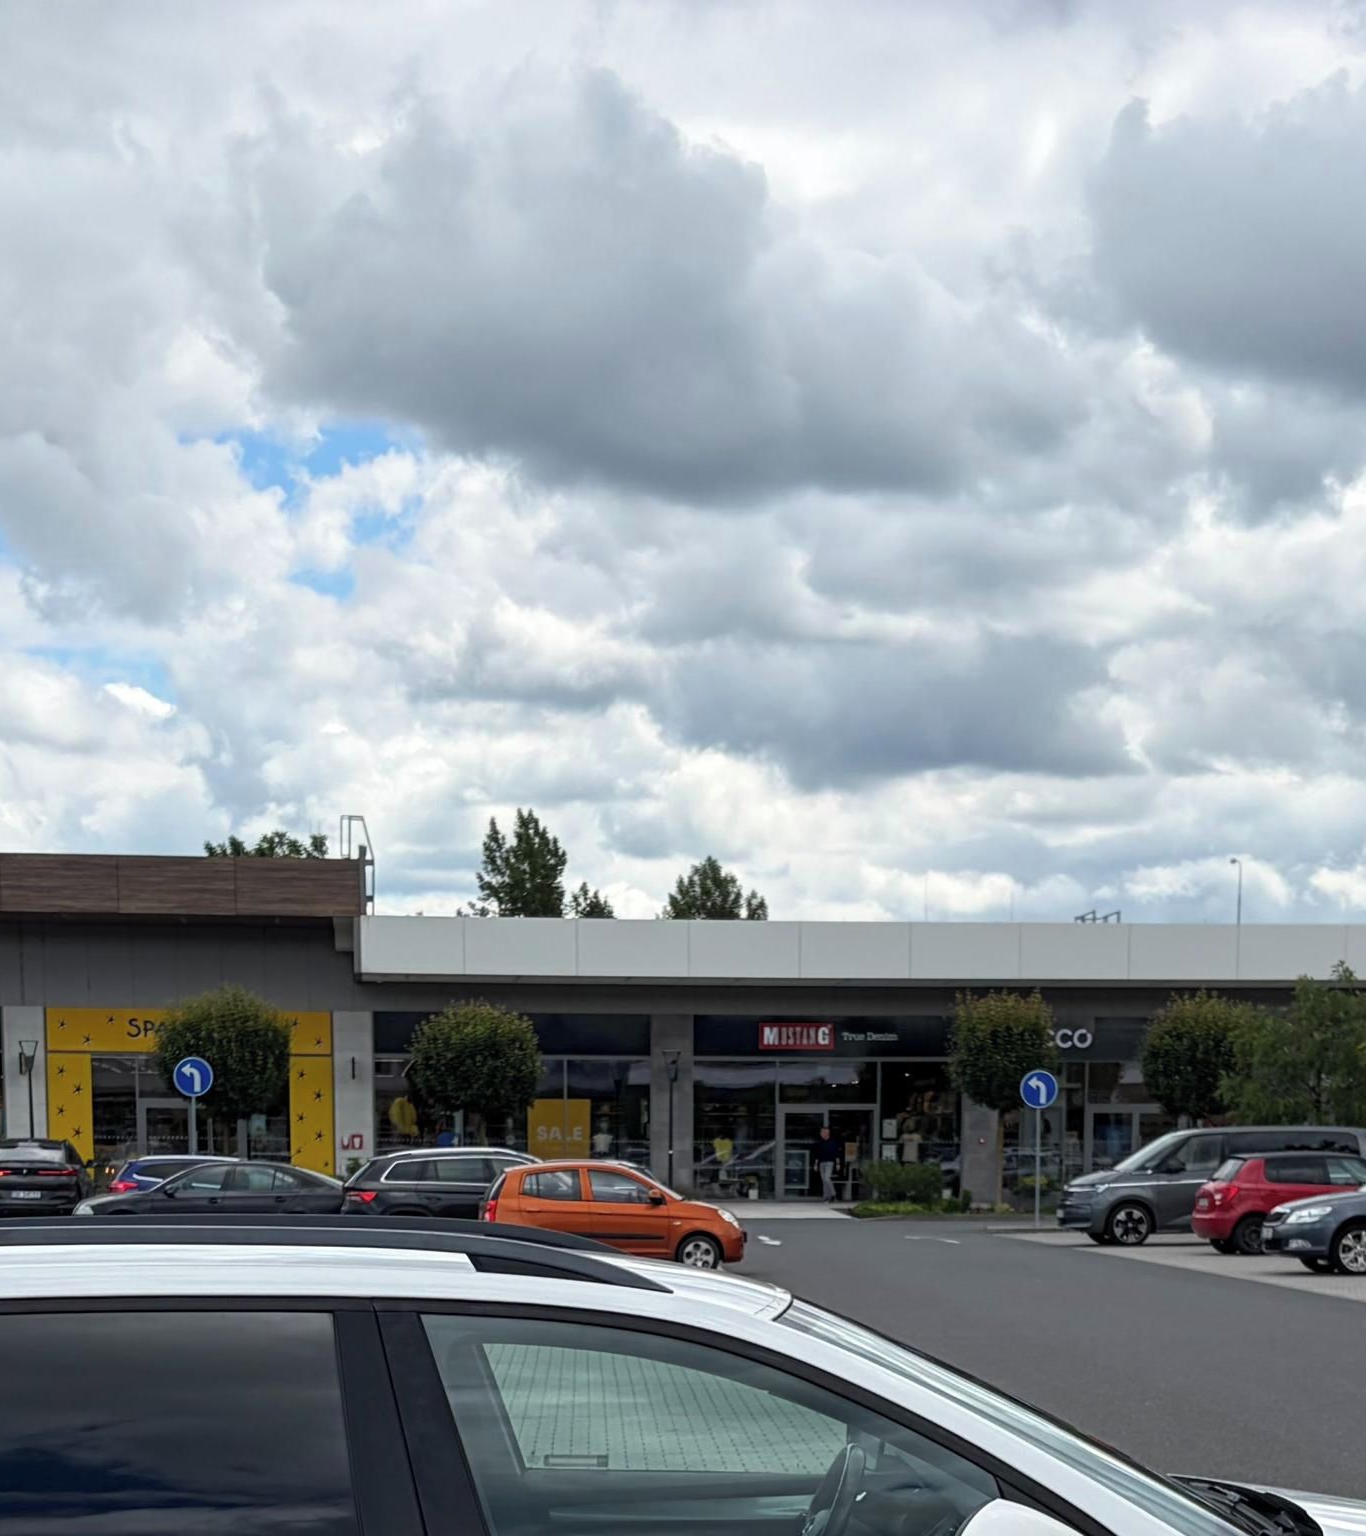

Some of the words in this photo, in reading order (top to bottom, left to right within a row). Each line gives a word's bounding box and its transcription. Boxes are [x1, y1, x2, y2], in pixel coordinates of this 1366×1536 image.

[763, 1026, 830, 1045] MUSTANG
[841, 1031, 865, 1041] True
[866, 1031, 899, 1041] Denim
[537, 1126, 583, 1142] SALE
